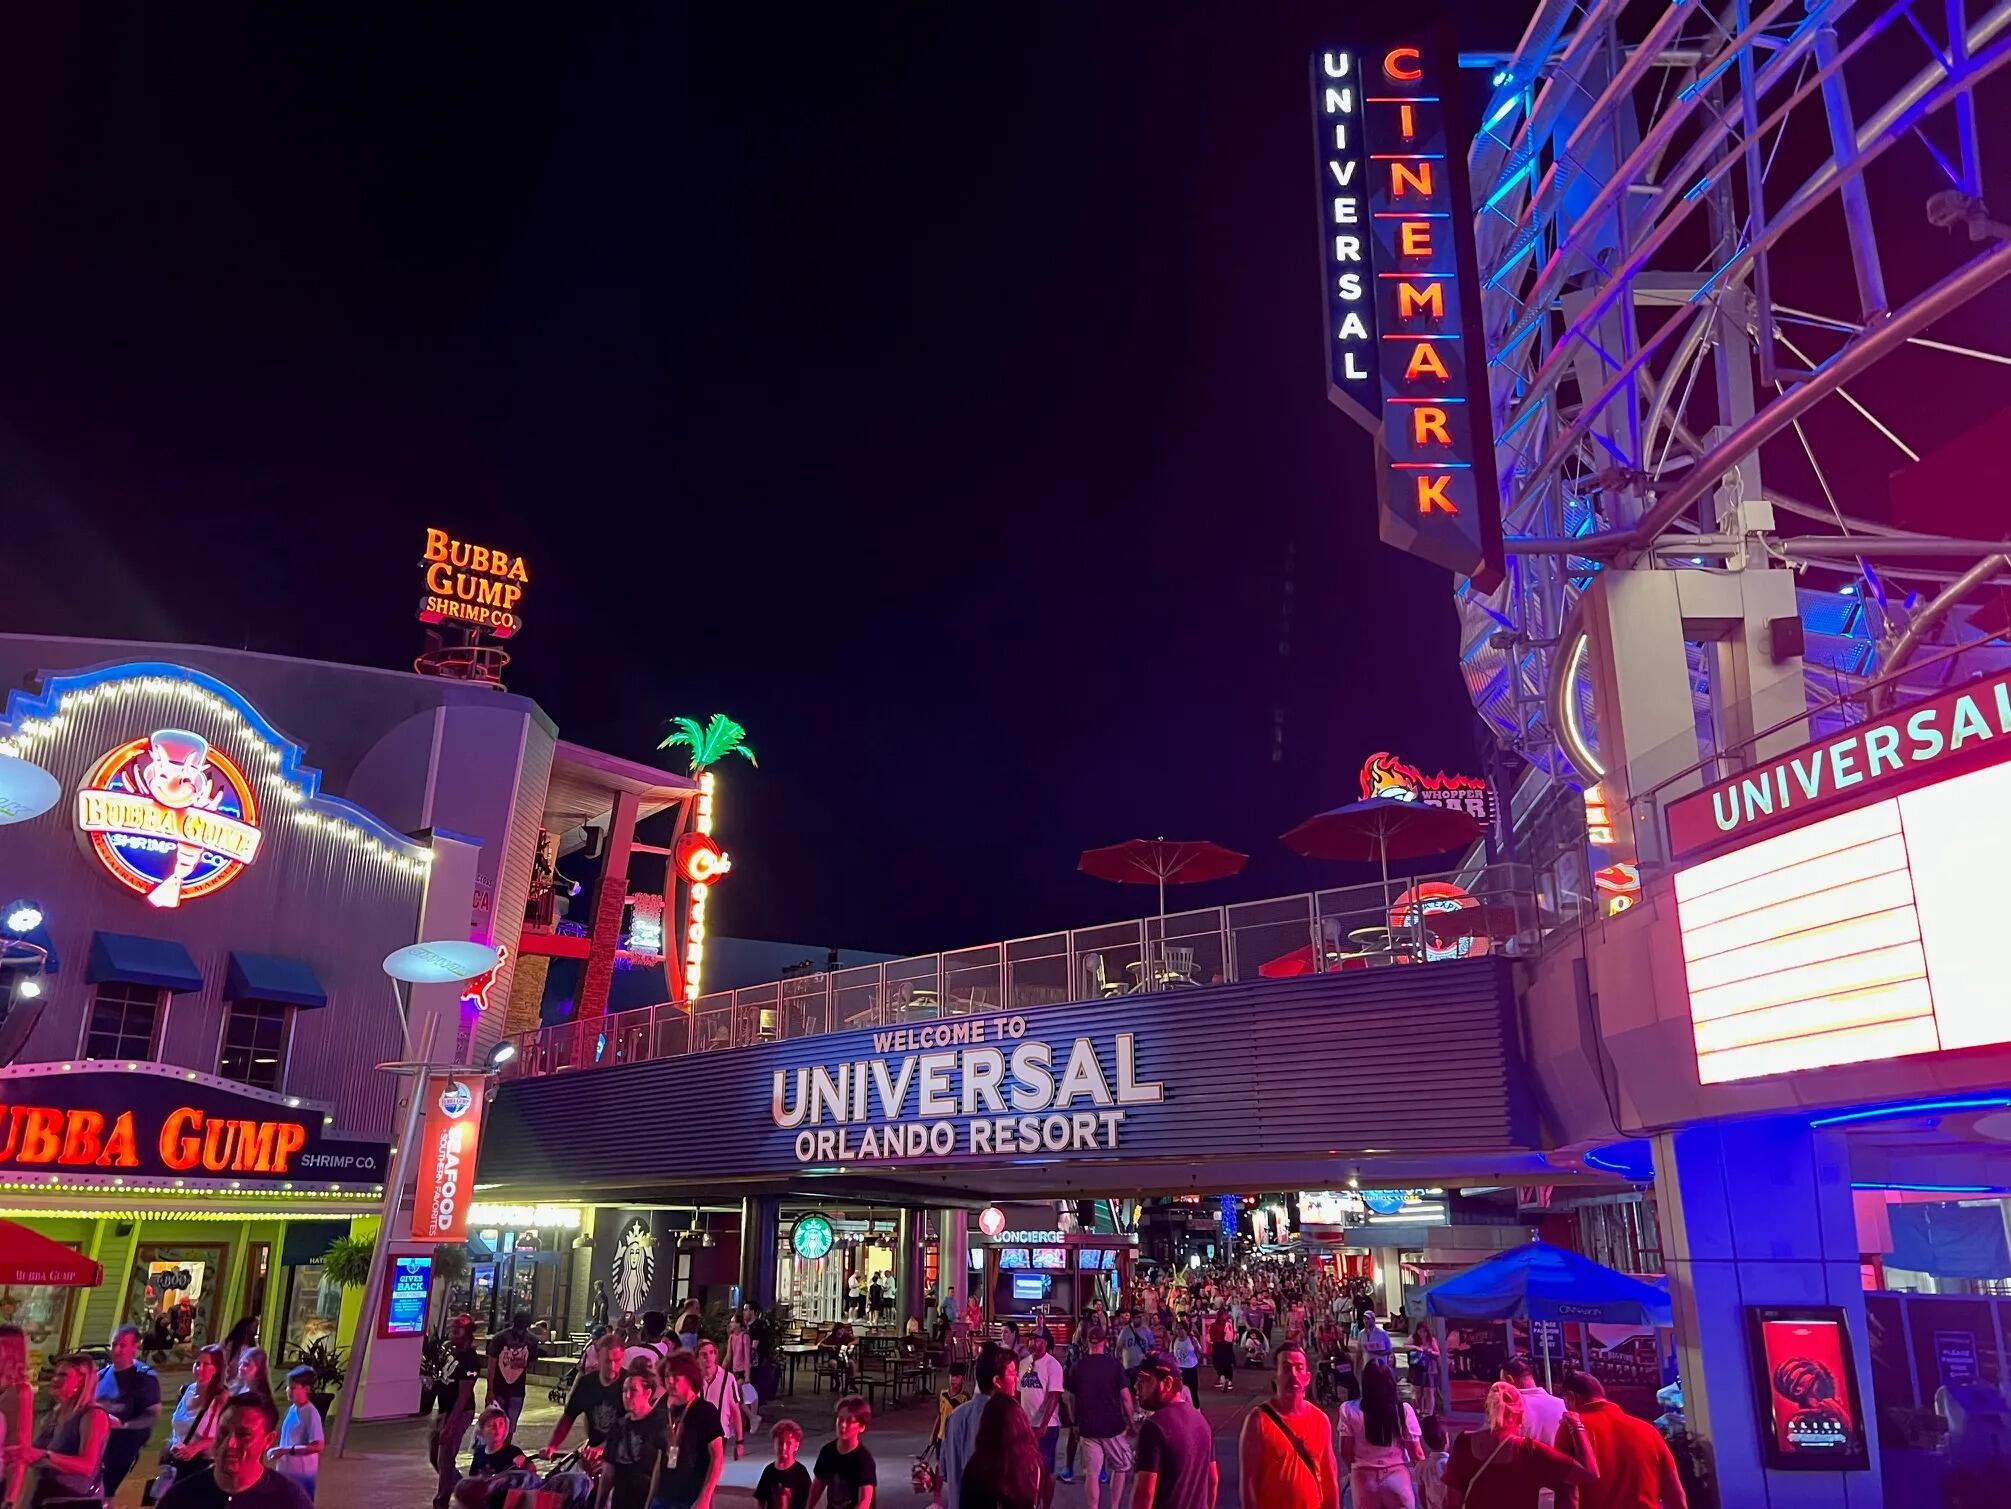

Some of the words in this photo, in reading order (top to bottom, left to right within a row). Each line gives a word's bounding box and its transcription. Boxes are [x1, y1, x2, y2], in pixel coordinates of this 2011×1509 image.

[1322, 53, 1367, 380] UNIVERSAL
[1383, 48, 1458, 514] CINEMARK
[423, 528, 528, 582] BUBBA
[427, 562, 521, 609] GUMP
[427, 596, 490, 622] SHRIMP
[491, 610, 517, 630] CO.
[1421, 789, 1484, 799] WHOPPER
[85, 796, 177, 837] BUBBA
[182, 812, 252, 858] GUMP
[111, 833, 177, 854] SHRIMP
[873, 1020, 985, 1054] WELCOME
[994, 1015, 1028, 1040] TO
[772, 1033, 1165, 1129] UNIVERSAL
[159, 1107, 306, 1172] GUMP
[433, 1133, 449, 1185] SOUTHERN
[795, 1120, 957, 1162] ORLANDO
[969, 1110, 1127, 1155] RESORT
[301, 1154, 354, 1168] SHRIMP
[355, 1156, 377, 1169] CO.
[428, 1186, 443, 1237] FAVORITES
[49, 1270, 76, 1281] GUMP
[397, 1282, 424, 1291] BACK
[400, 1275, 424, 1283] GIVES
